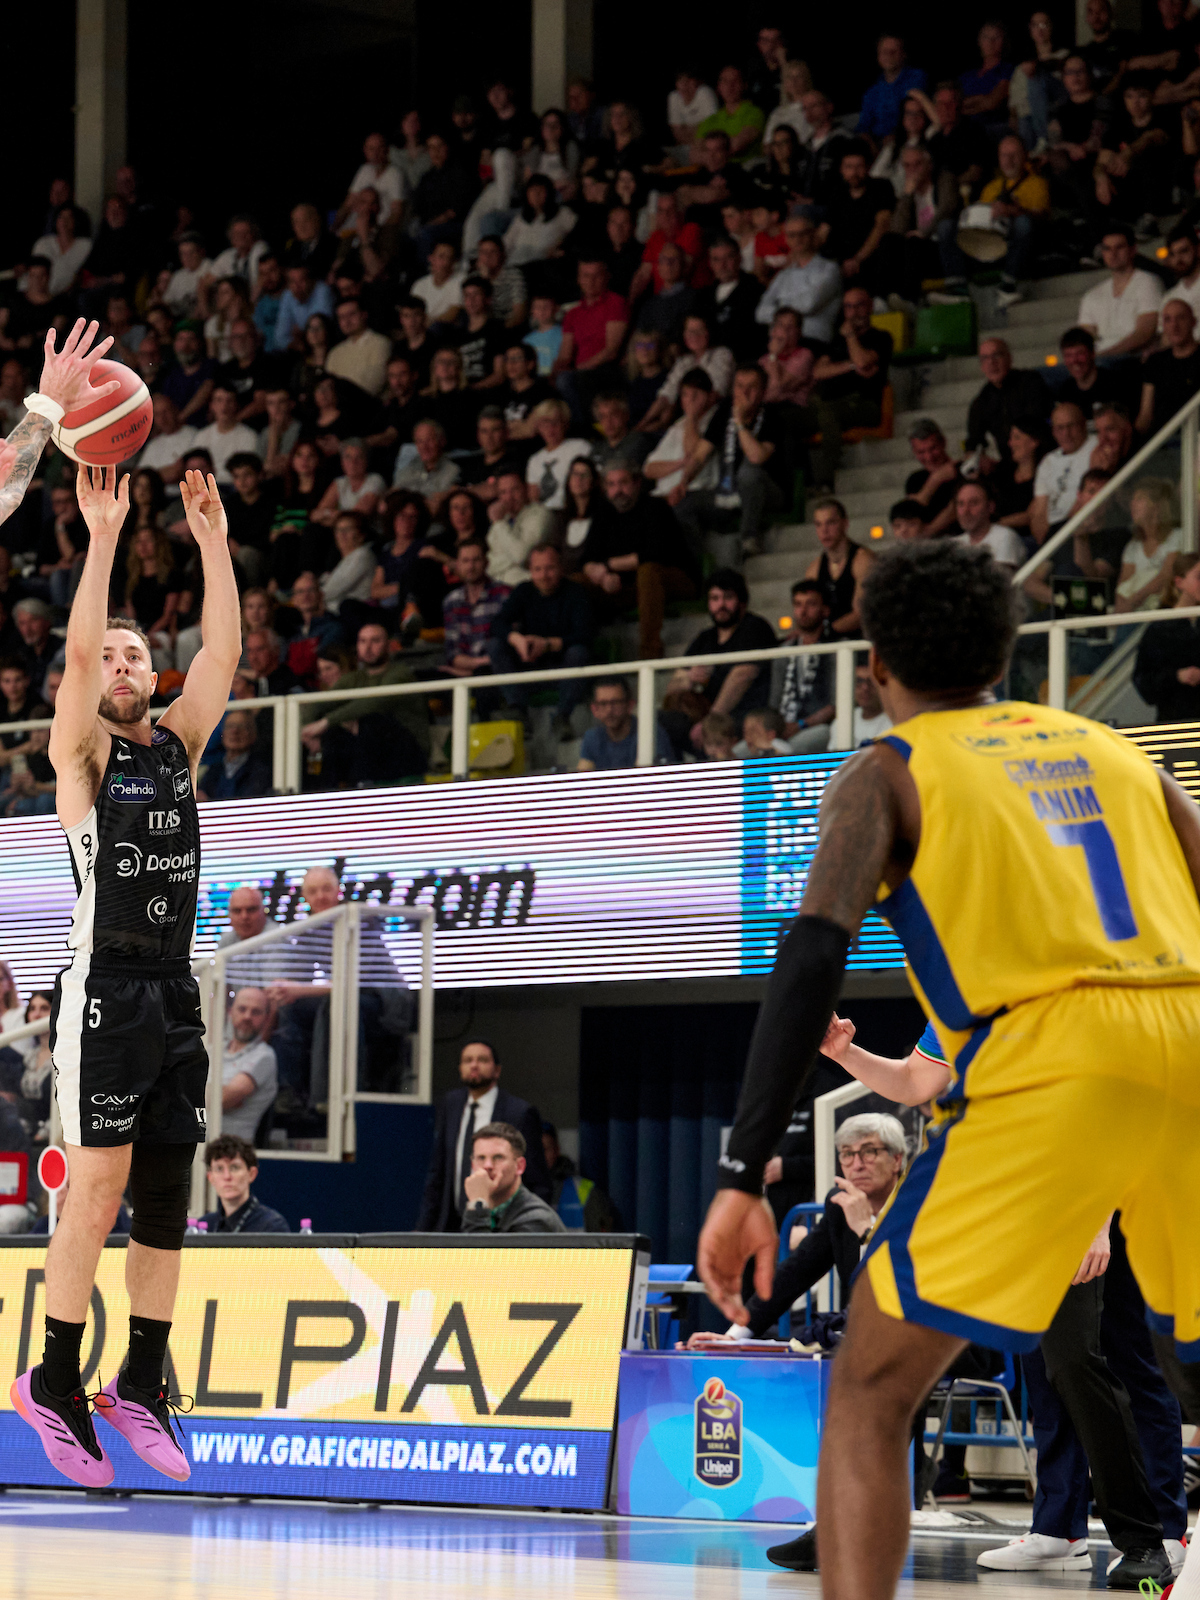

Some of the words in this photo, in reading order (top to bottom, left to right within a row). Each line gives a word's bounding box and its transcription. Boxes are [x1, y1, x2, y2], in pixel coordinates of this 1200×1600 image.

[110, 414, 148, 444] molten
[110, 782, 154, 795] Melinda
[1028, 785, 1104, 821] ANIM
[148, 808, 181, 830] ITAS
[88, 998, 103, 1029] 5
[700, 1420, 738, 1441] LBA
[191, 1431, 578, 1477] WWW.GRAFICHEDALPIAZ.COM
[703, 1458, 735, 1478] Unipol
